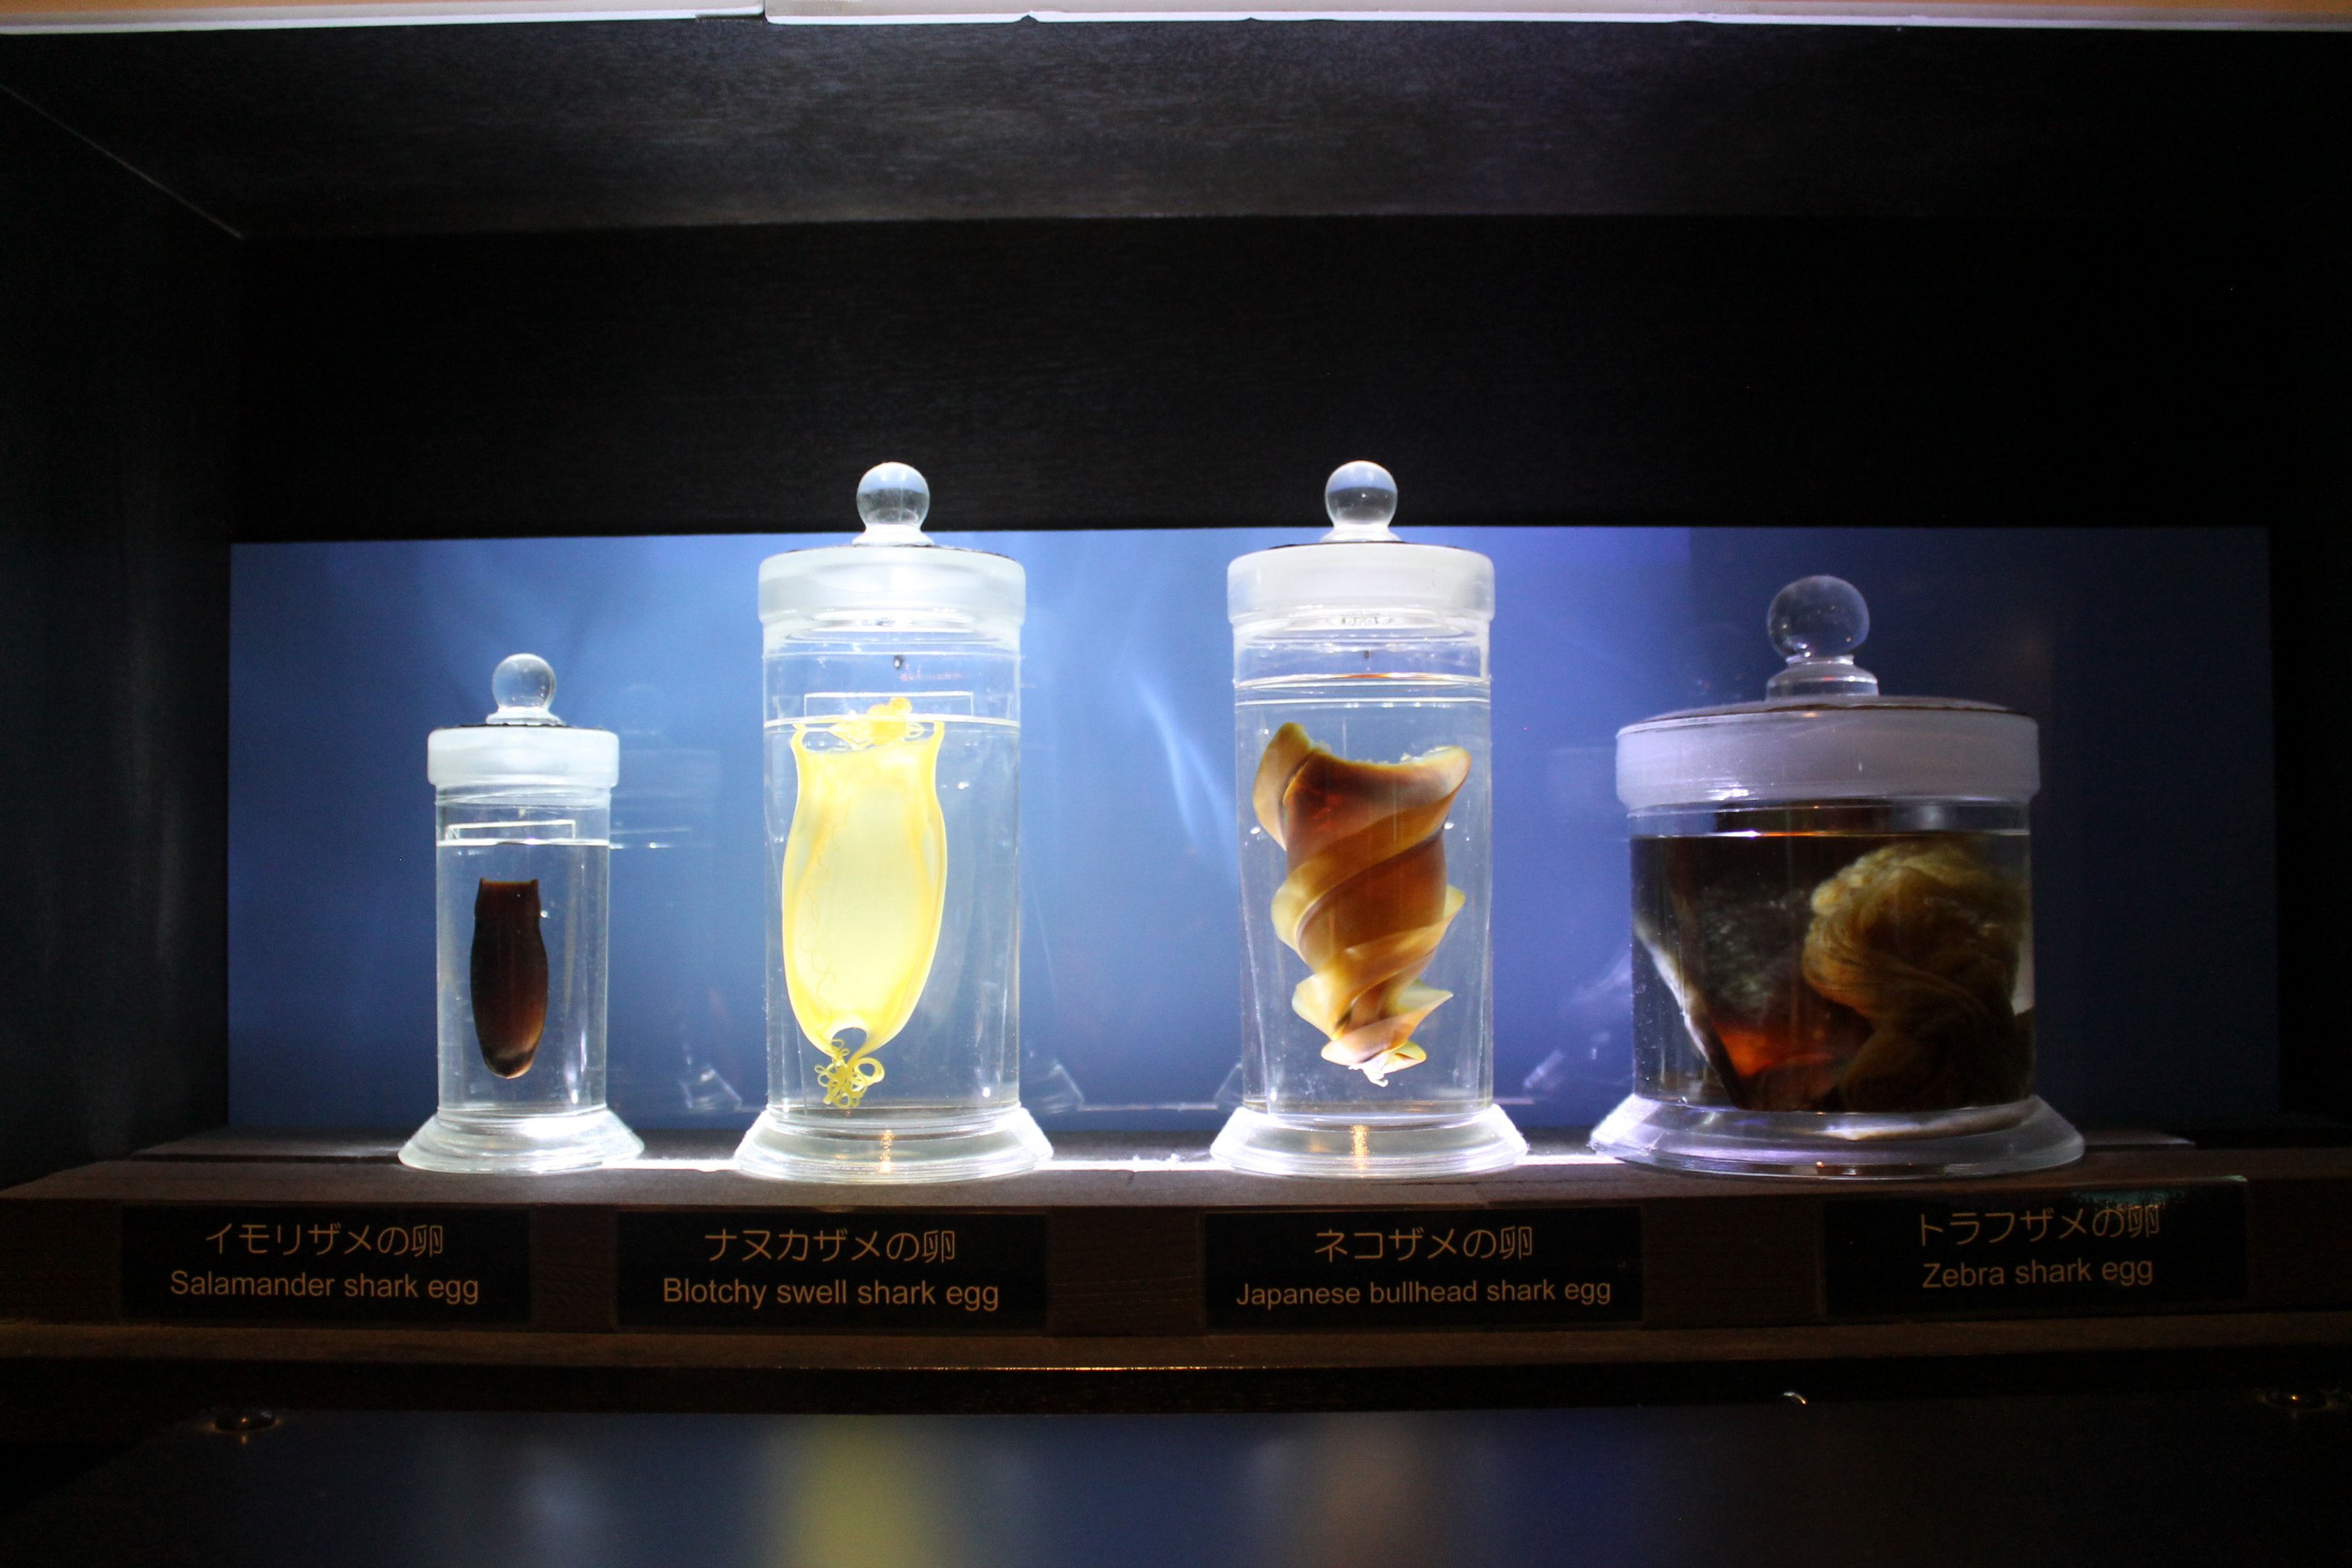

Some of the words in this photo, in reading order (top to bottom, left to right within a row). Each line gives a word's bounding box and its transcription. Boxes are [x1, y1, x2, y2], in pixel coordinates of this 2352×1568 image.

[205, 1222, 444, 1257] イモリザメの卵
[1920, 1201, 2161, 1247] トラフザメの卵
[704, 1228, 956, 1264] ナヌカザメの卵
[1314, 1225, 1533, 1263] ネコザメの卵
[169, 1270, 335, 1297] Salamander
[343, 1273, 419, 1299] shark
[428, 1279, 479, 1305] egg
[1922, 1262, 2005, 1289] Zebra
[2014, 1258, 2093, 1285] shark
[2101, 1259, 2153, 1286] egg
[663, 1278, 767, 1310] Blotchy
[776, 1279, 846, 1304] swell
[857, 1281, 936, 1306] shark
[946, 1284, 999, 1312] egg
[1236, 1283, 1361, 1310] Japanese
[1369, 1280, 1478, 1304] bullhead
[1487, 1279, 1556, 1302] shark
[1564, 1281, 1611, 1305] egg
